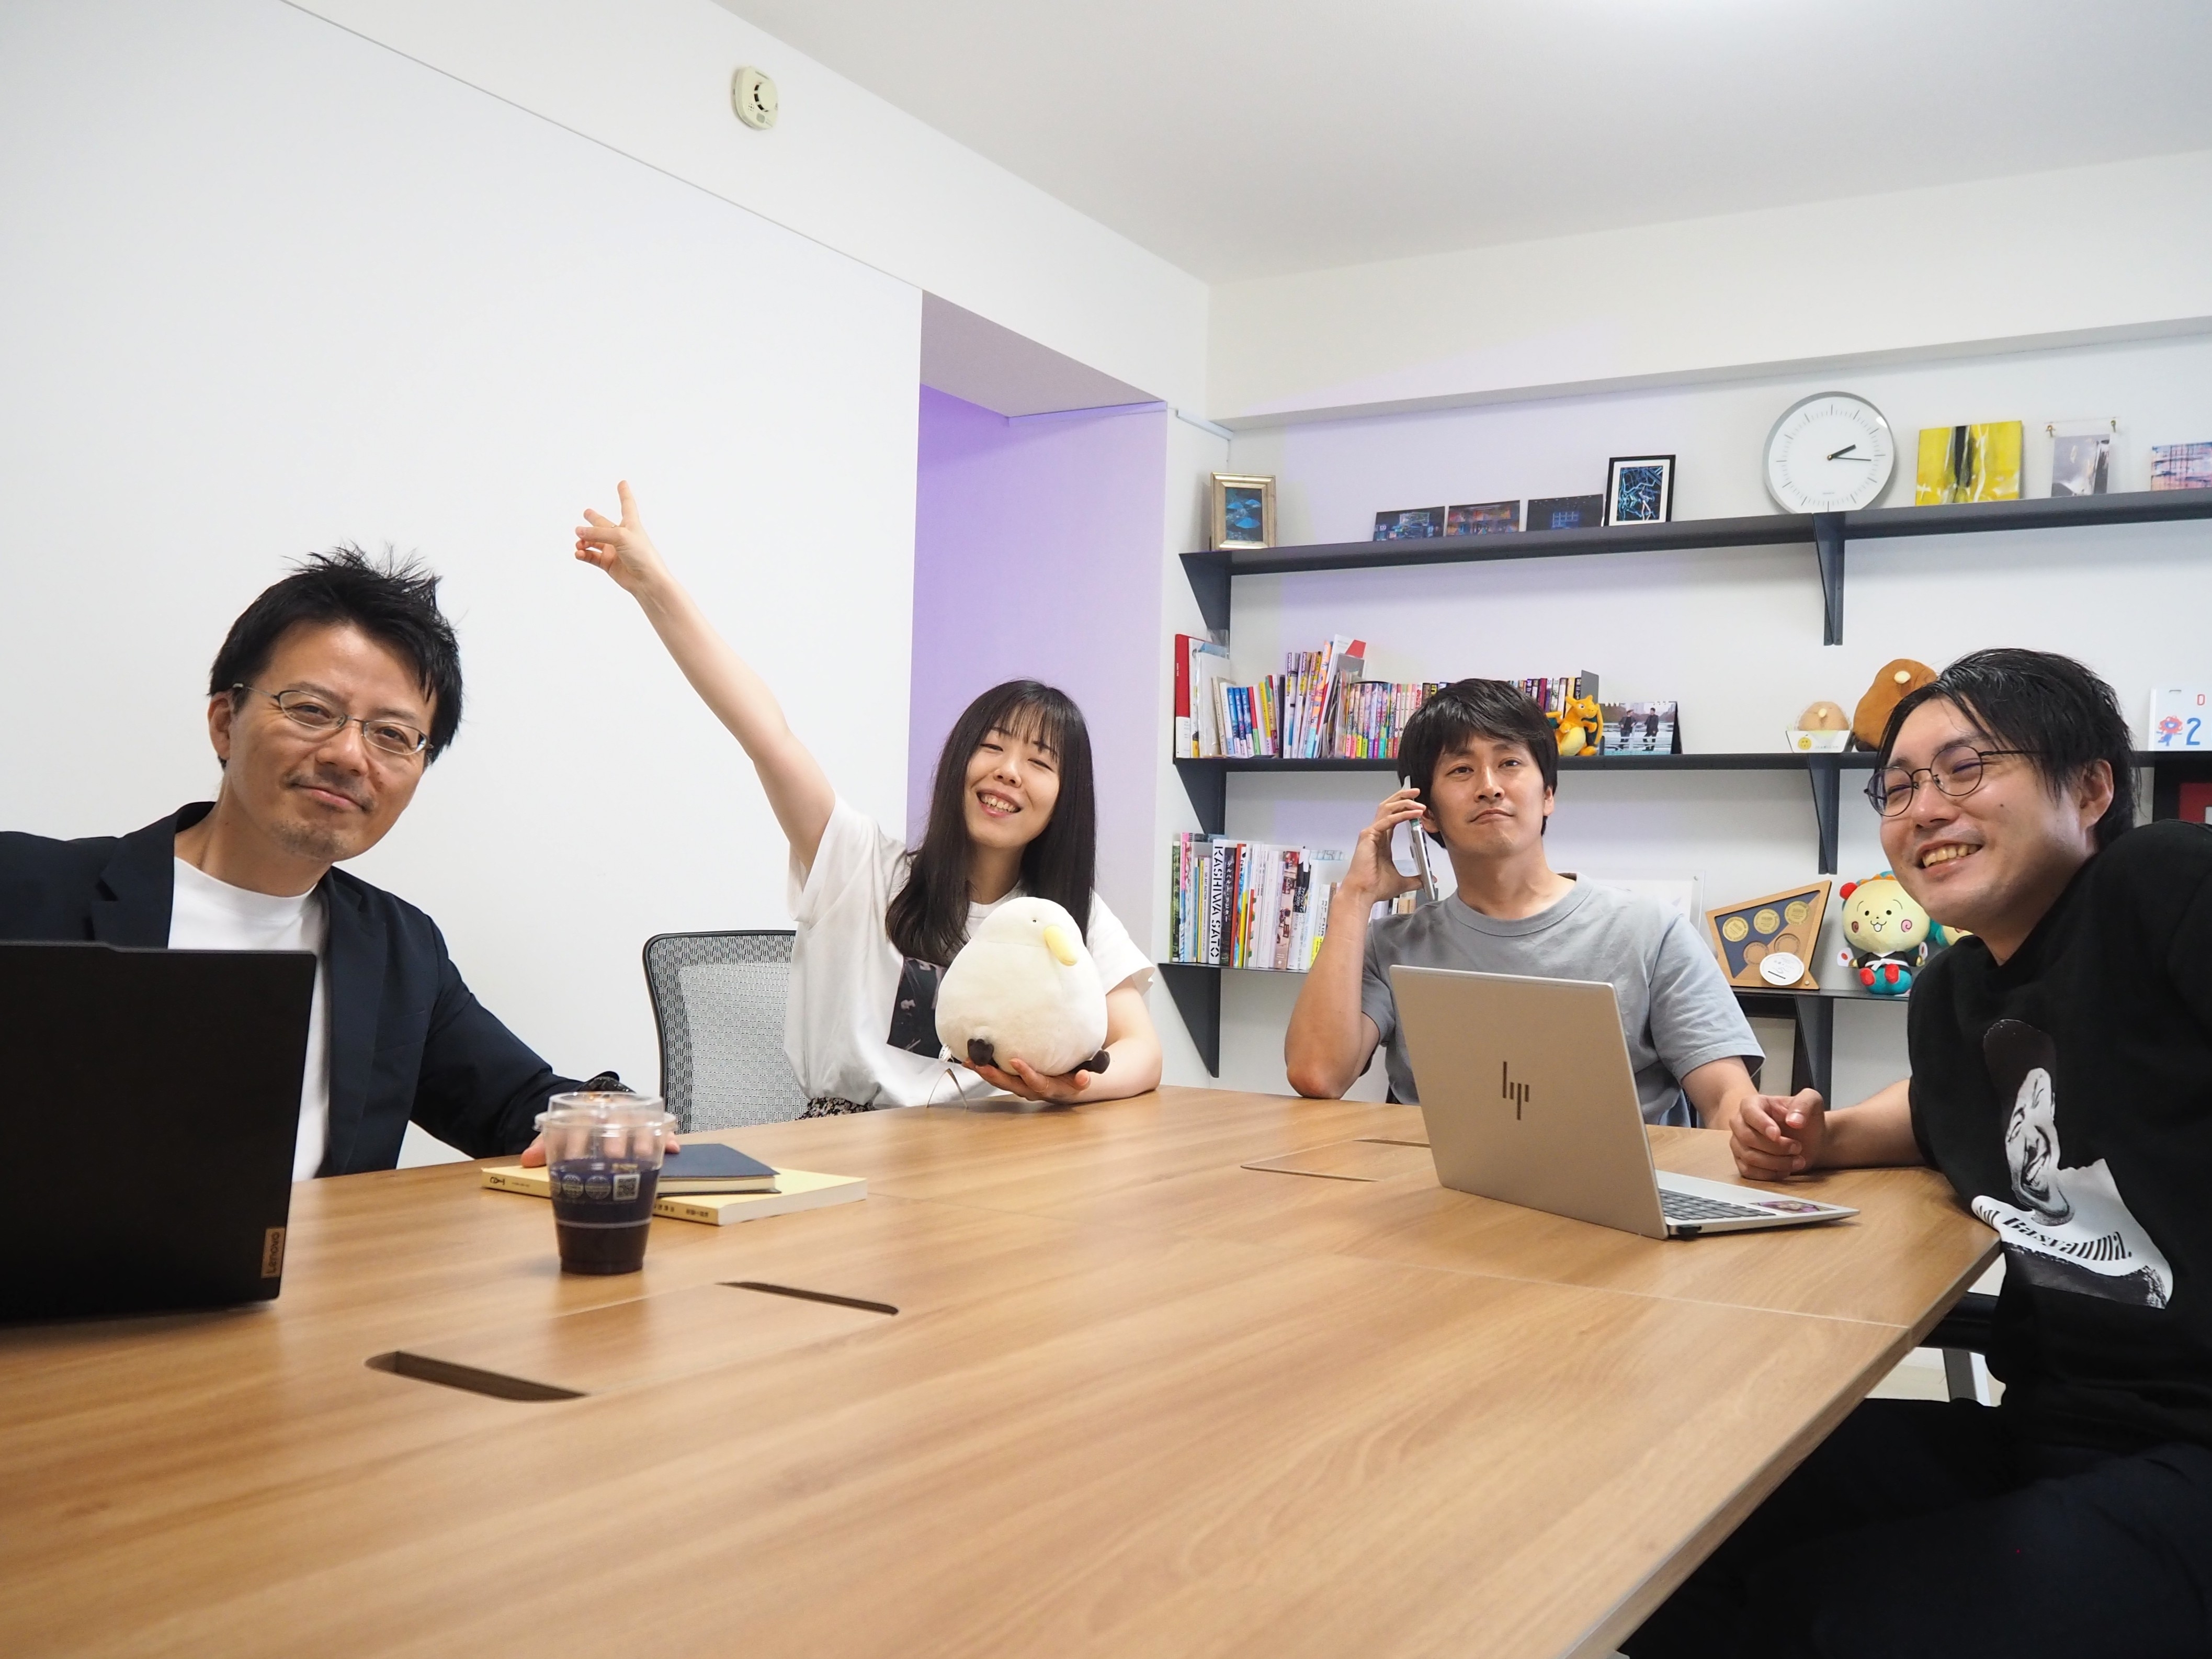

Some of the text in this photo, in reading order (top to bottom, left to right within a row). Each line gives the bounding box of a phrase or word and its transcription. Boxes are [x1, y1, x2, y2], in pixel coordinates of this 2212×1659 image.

[1210, 846, 1223, 957] KASHIWA SATO
[1502, 1061, 1530, 1121] hp
[266, 1232, 280, 1274] Lenovo
